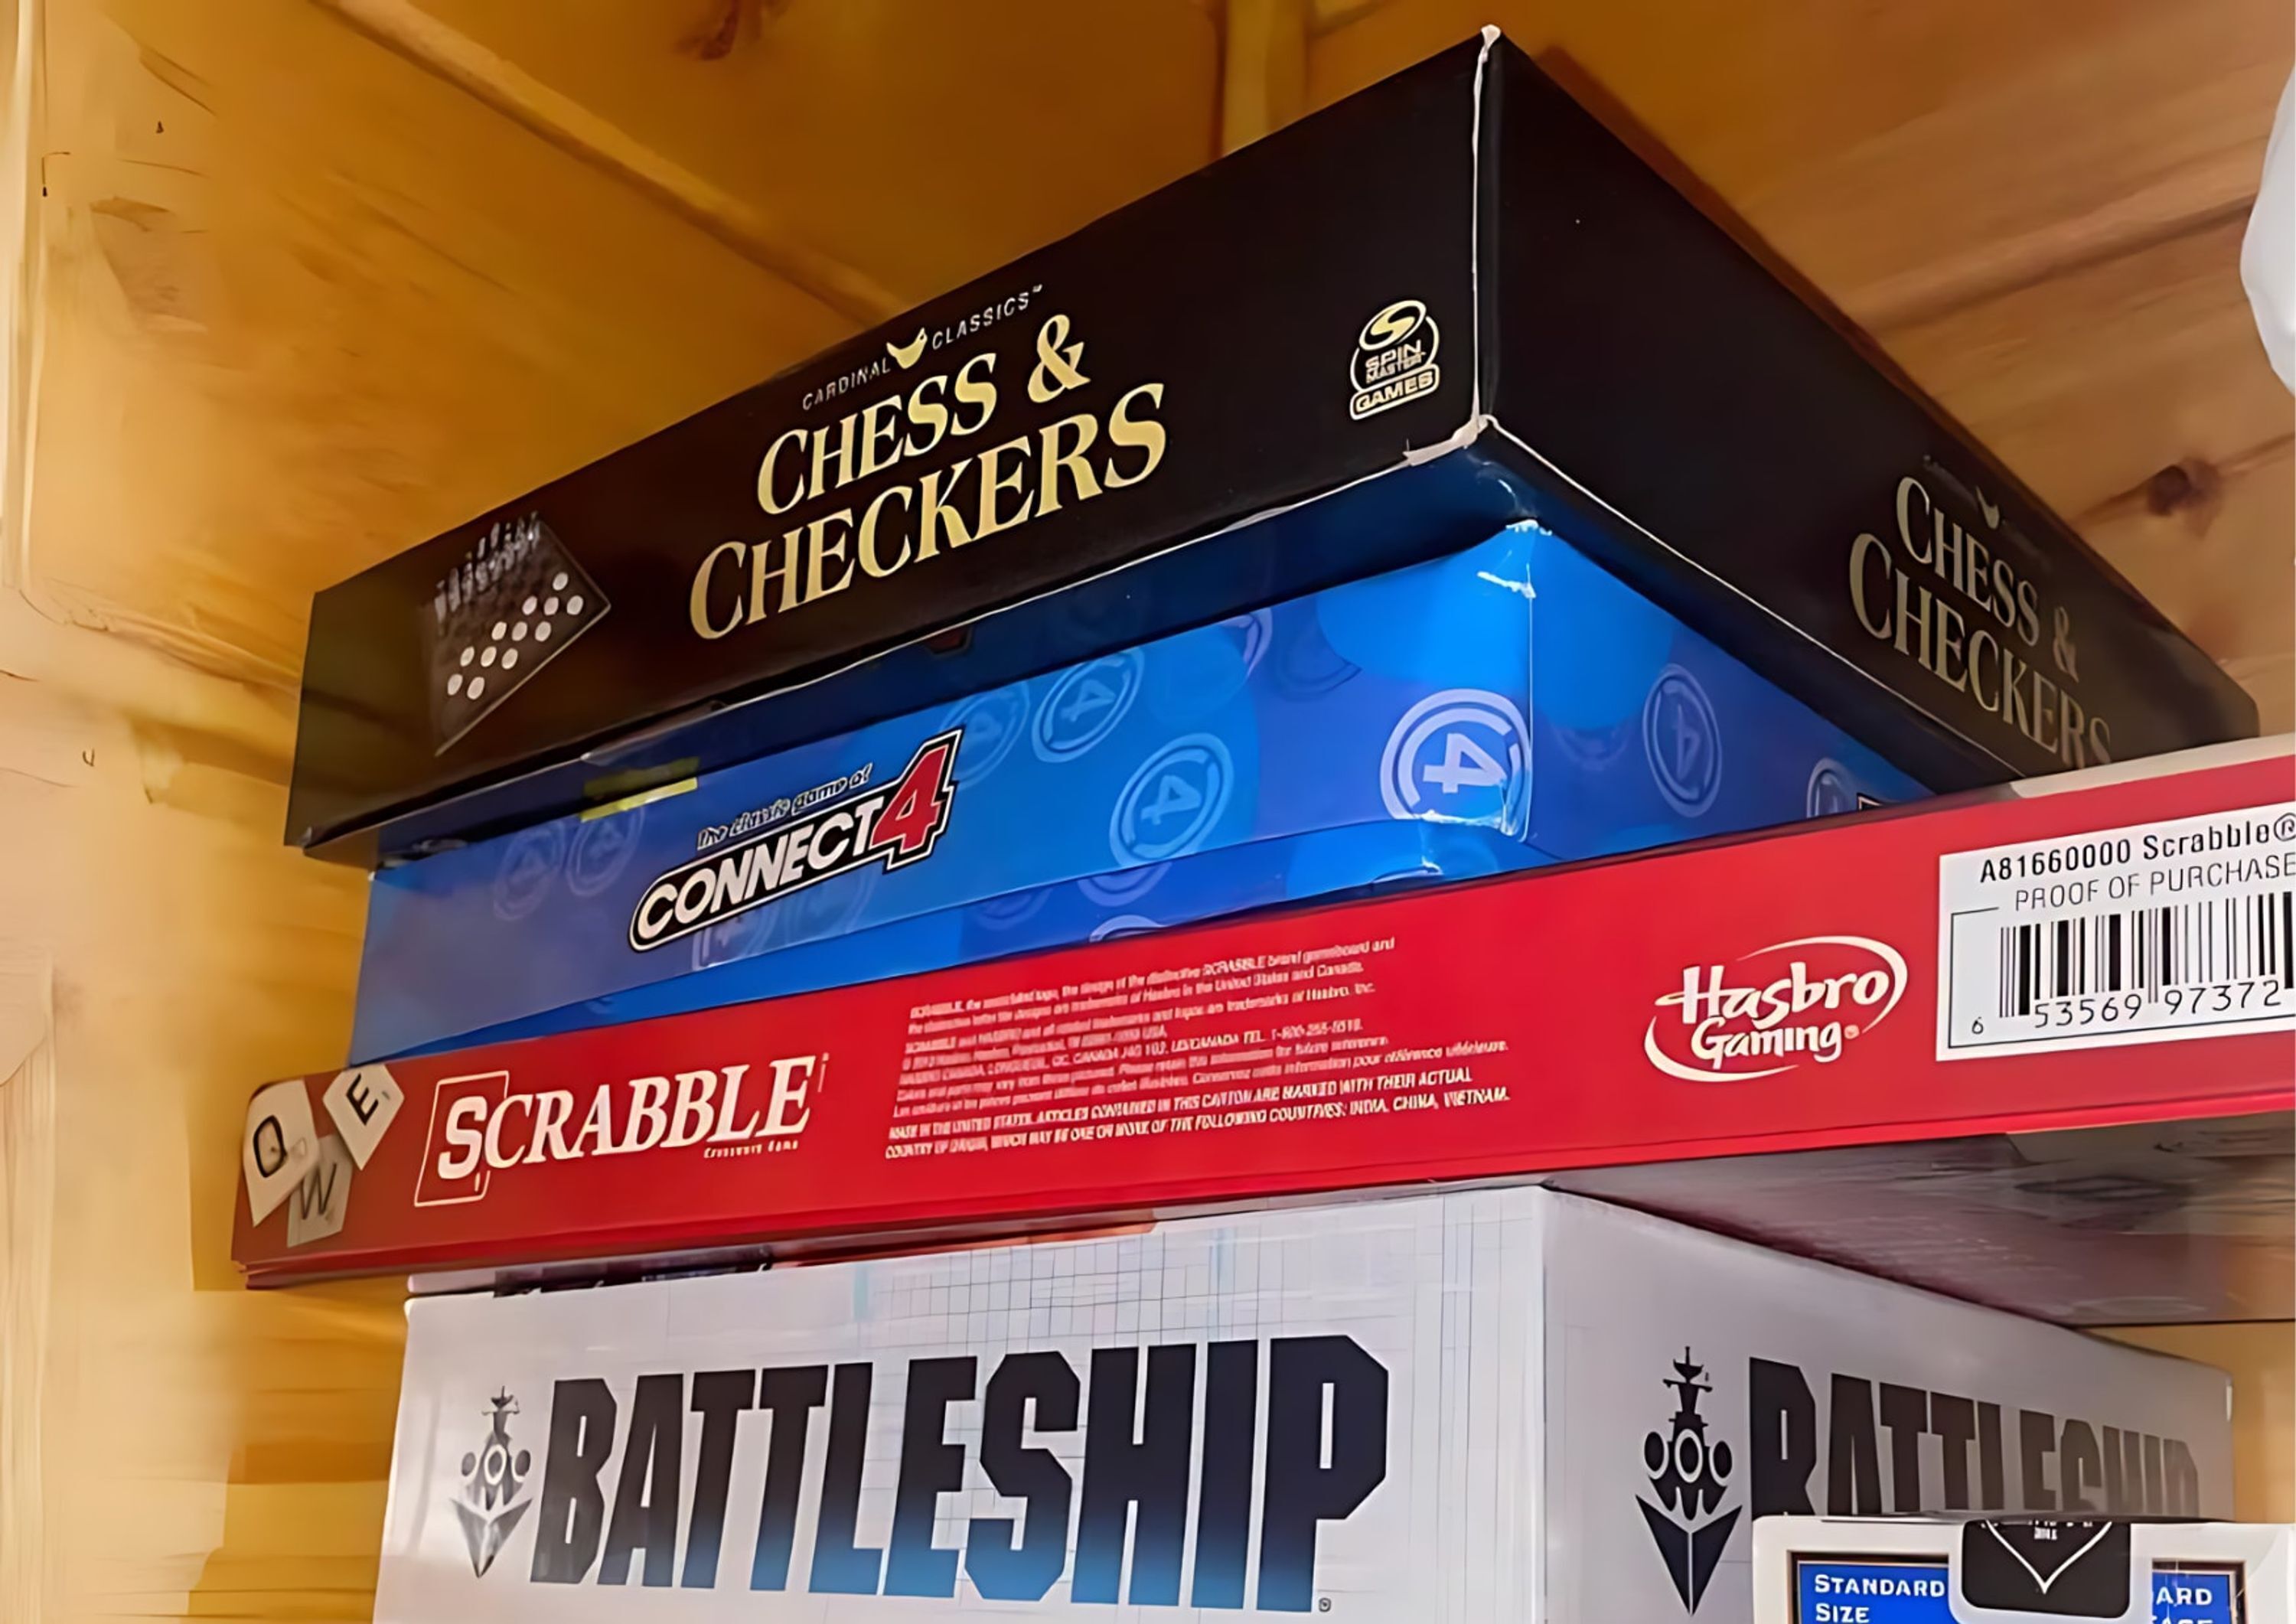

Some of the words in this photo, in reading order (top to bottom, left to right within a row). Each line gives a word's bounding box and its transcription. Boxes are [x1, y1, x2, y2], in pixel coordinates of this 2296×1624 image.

[1365, 339, 1421, 369] SPIN
[802, 357, 891, 410] CARDINAL
[1355, 371, 1433, 413] GAMES
[757, 352, 996, 515] CHESS
[1027, 314, 1092, 404] &
[689, 383, 1166, 641] CHECKERS
[1896, 477, 2040, 647] CHESS
[1980, 839, 2131, 883] A81660000
[2015, 879, 2101, 911] PROOF
[2108, 873, 2141, 899] OF
[2151, 852, 2295, 895] PURCHASE
[1655, 961, 1890, 1030] Hasbro
[1971, 1016, 1985, 1035] 6
[2034, 993, 2142, 1029] 53569
[2164, 980, 2282, 1016] 97372
[1691, 1016, 1842, 1070] Gaming
[436, 1055, 817, 1180] SCRABBLE
[530, 1335, 1388, 1613] BATTLESHIP
[1815, 1574, 1945, 1597] STANDARD
[1815, 1603, 1870, 1623] SIZE
